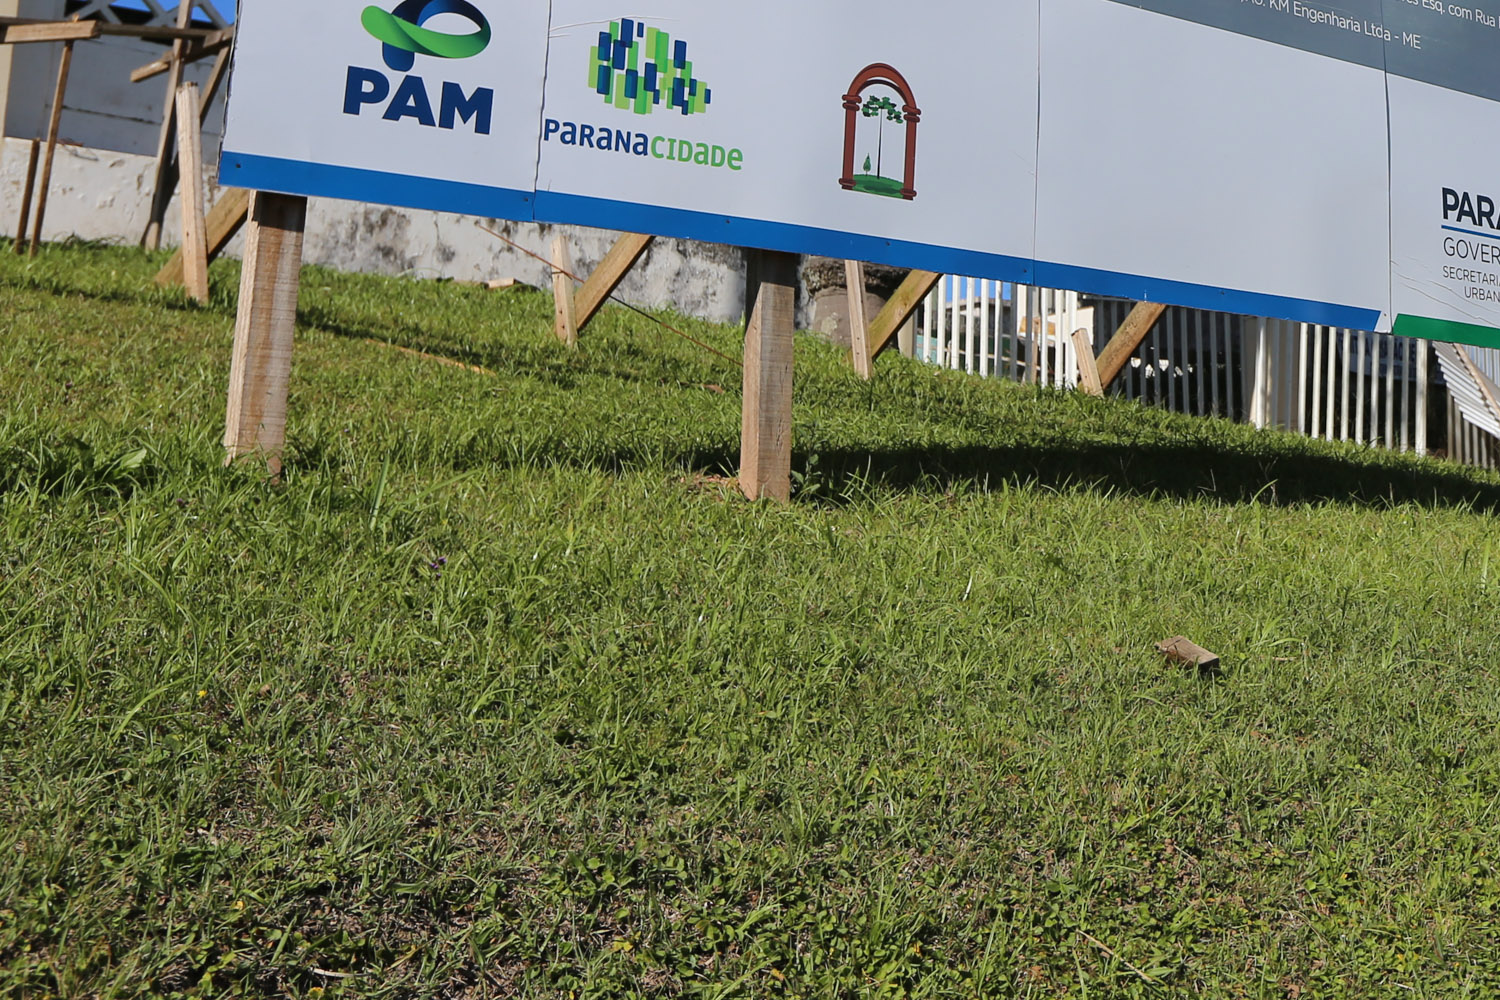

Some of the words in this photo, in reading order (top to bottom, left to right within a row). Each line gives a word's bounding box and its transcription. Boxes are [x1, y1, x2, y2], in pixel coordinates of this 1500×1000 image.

[1293, 1, 1361, 33] Engenharia
[1364, 20, 1391, 41] Ltda
[1402, 31, 1422, 50] ME
[1448, 4, 1472, 21] com
[1475, 9, 1496, 27] Rua
[343, 65, 494, 135] PAM
